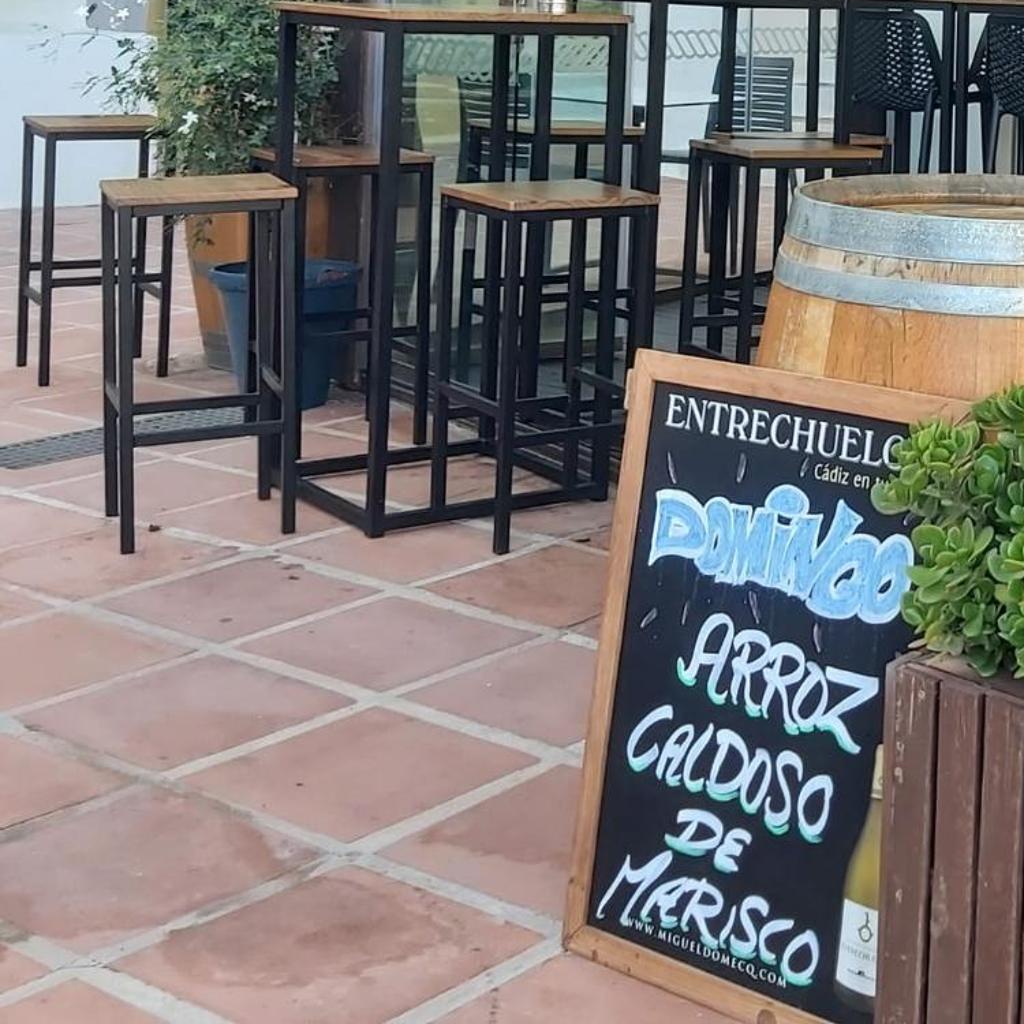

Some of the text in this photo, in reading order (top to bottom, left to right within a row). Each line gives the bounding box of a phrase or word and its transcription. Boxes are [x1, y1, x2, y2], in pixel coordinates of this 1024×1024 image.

[814, 463, 849, 485] Cádiz
[853, 476, 871, 489] en
[677, 613, 879, 755] ARROZ
[627, 704, 834, 844] CALDOSO
[664, 809, 752, 873] DE
[596, 850, 820, 987] MARISCO
